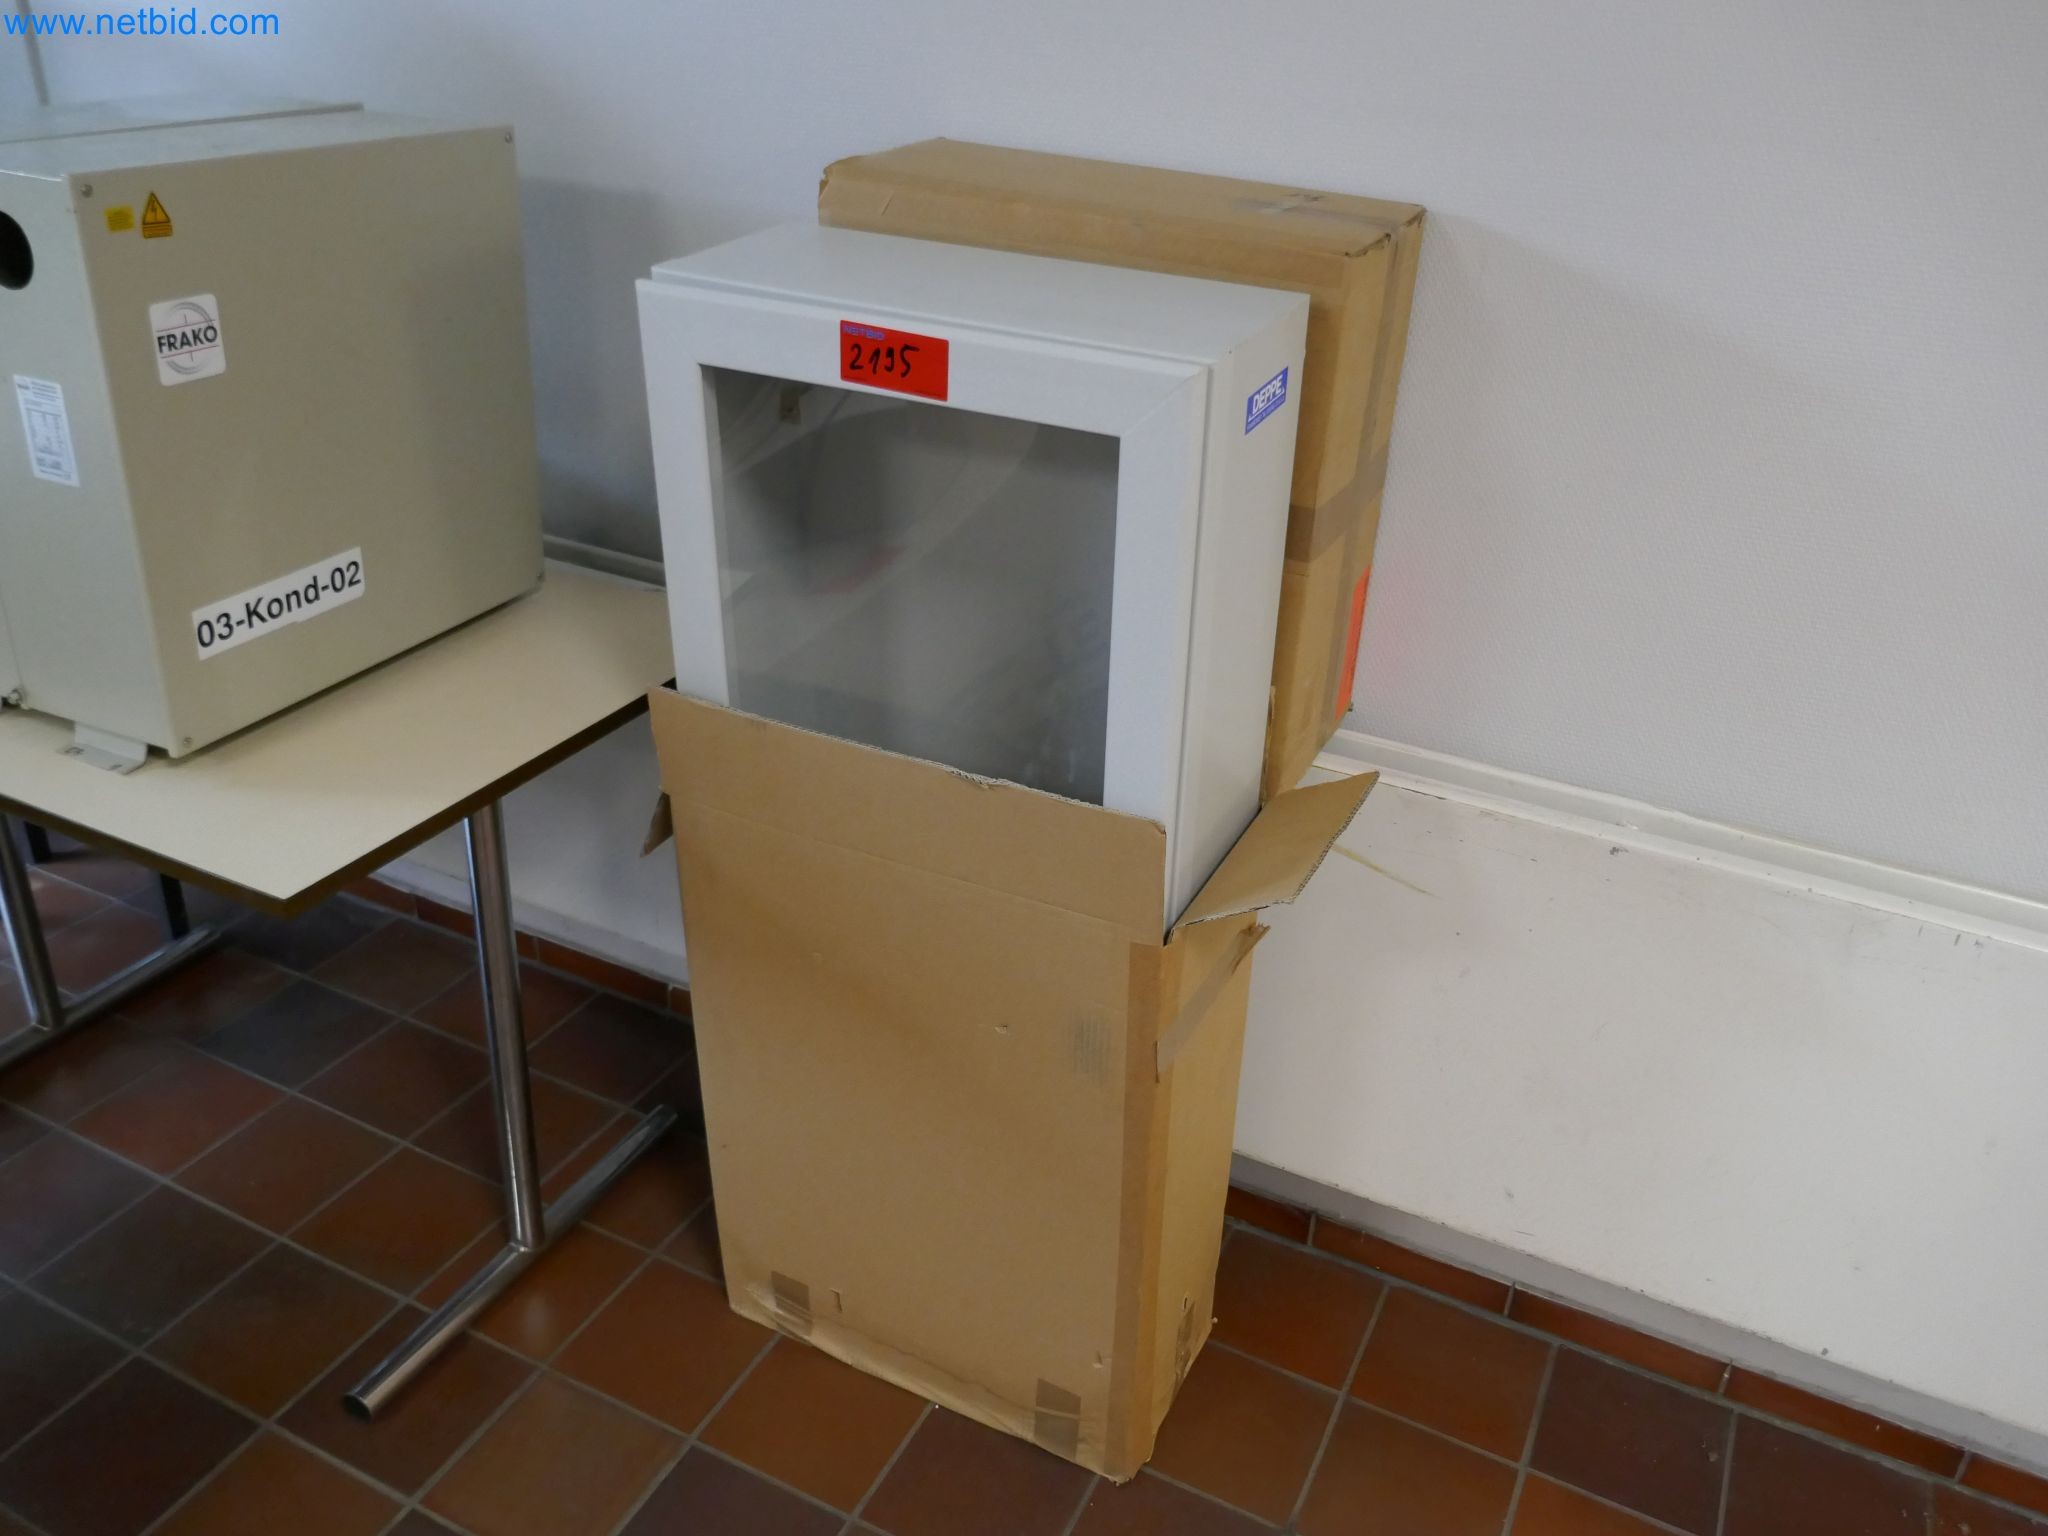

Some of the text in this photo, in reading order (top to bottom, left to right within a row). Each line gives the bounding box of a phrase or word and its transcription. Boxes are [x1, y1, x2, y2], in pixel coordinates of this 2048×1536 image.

[157, 325, 218, 354] FRAKO
[849, 343, 920, 378] 2195
[1252, 374, 1284, 415] DEPPE
[197, 561, 361, 648] 03-Kond-02
